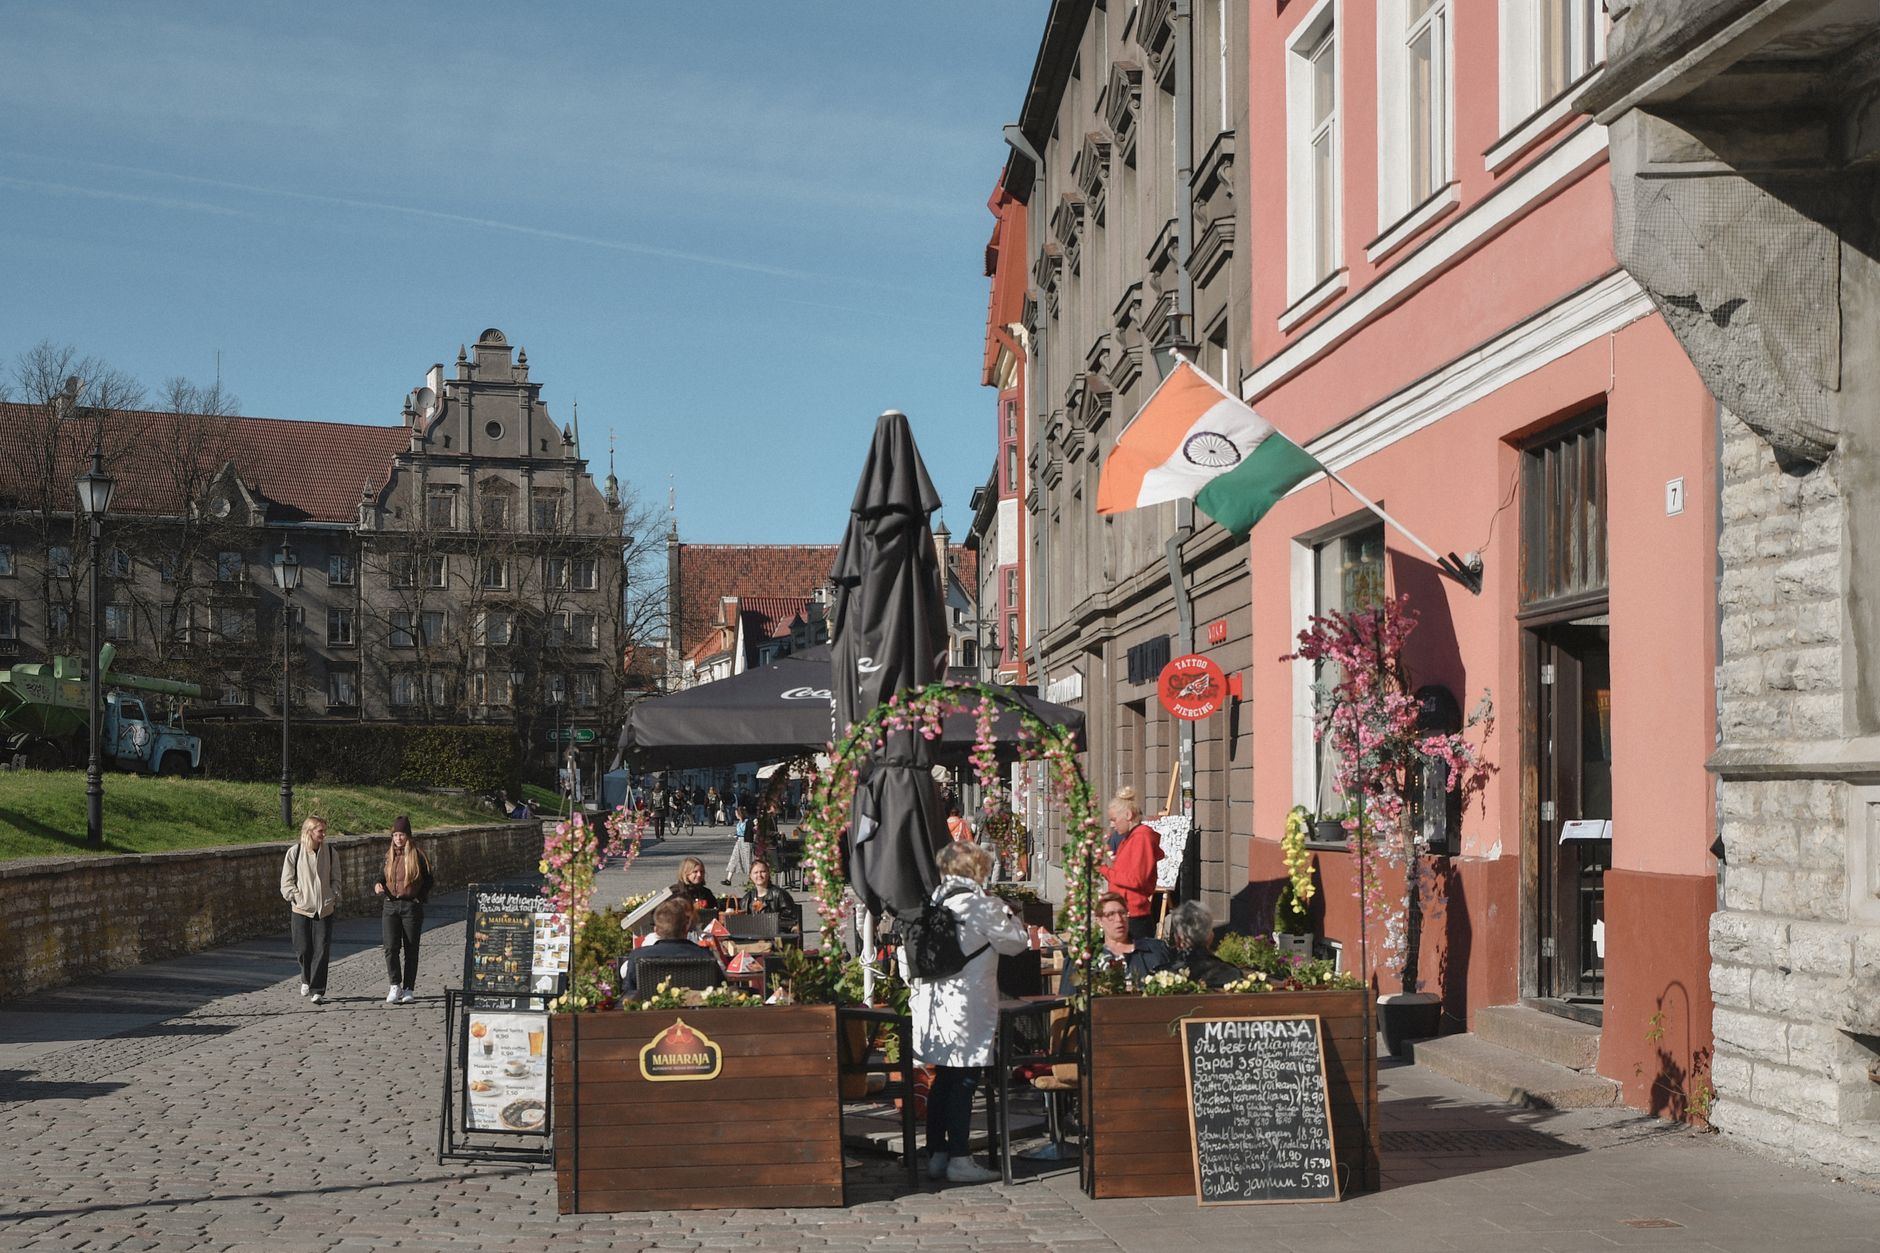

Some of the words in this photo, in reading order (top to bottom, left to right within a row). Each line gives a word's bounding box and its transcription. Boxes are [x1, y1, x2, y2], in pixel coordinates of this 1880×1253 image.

[1671, 487, 1677, 507] 7
[1175, 659, 1208, 670] TATTOO
[1173, 702, 1214, 717] PIERCING
[1204, 1020, 1312, 1040] MAHARAJA
[1194, 1038, 1216, 1054] The
[1220, 1039, 1246, 1054] best
[652, 1053, 710, 1066] MAHARAJA
[1195, 1056, 1233, 1074] Papad
[1238, 1057, 1263, 1070] 3.50
[1275, 1150, 1303, 1163] 11.90
[1304, 1157, 1331, 1170] 15.90
[1301, 1172, 1330, 1188] 5.90
